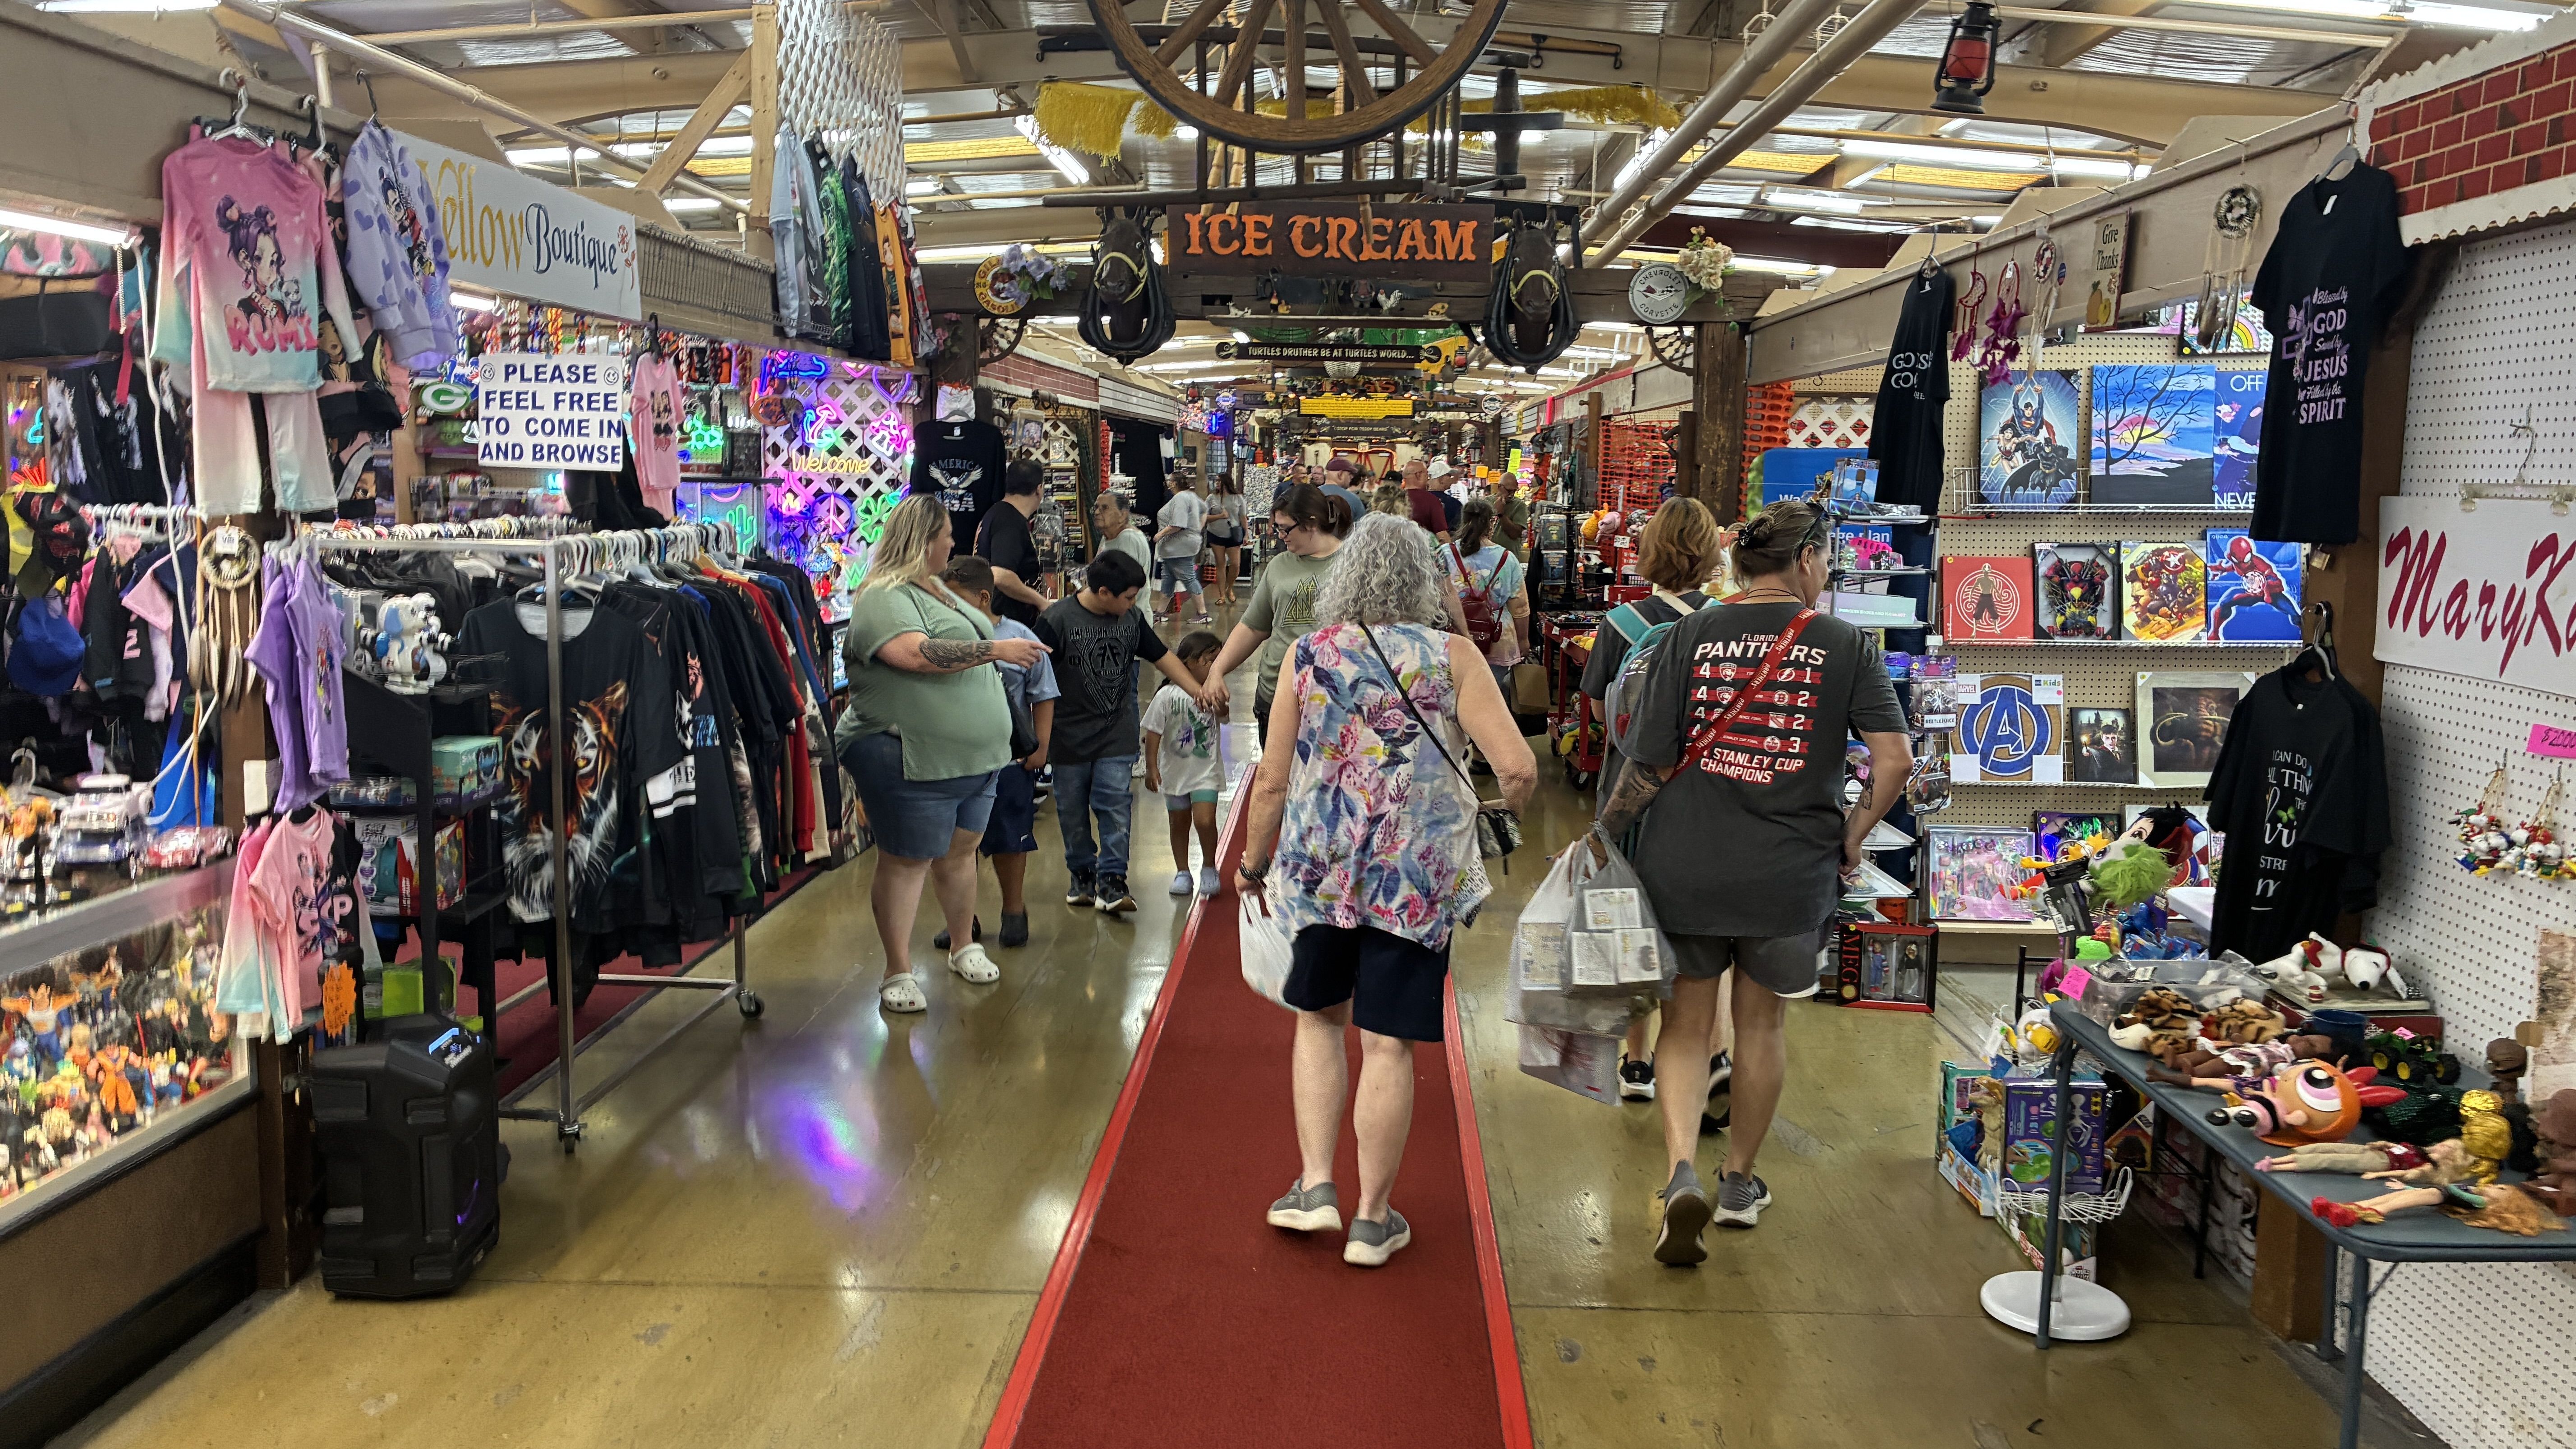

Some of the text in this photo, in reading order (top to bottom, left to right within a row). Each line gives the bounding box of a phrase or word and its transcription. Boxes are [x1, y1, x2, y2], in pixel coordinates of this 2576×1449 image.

[526, 203, 618, 290] Boutique
[1184, 212, 1478, 262] ICE CREAM
[1639, 269, 1681, 285] CHEVROLET
[1639, 303, 1679, 317] CORVETTE
[2313, 308, 2347, 334] GOD
[224, 302, 318, 357] RUMI
[1248, 346, 1281, 356] TURTLES
[1282, 347, 1319, 357] DRUTHER
[1320, 349, 1330, 357] BE
[1332, 349, 1343, 358] AT
[1345, 349, 1378, 358] TURTLES
[504, 363, 597, 384] PLEASE
[2303, 354, 2348, 382] JESUS
[2230, 374, 2264, 392] OFF
[484, 390, 618, 412] FEEL FREE
[2299, 397, 2346, 424] SPIRIT
[481, 416, 622, 439] TO COME IN
[480, 442, 620, 465] AND BROWSE
[791, 448, 870, 474] Welcome
[931, 458, 980, 471] AMERICA
[1742, 633, 1779, 642] FLORIDA
[1775, 627, 1794, 654] PANTHERS
[1693, 641, 1826, 666] PANTHRS
[1699, 662, 1812, 684] 4 1
[1750, 662, 1770, 690] PANTHERS
[1696, 685, 1707, 701] 4
[1797, 690, 1810, 707] 2
[1694, 706, 1706, 719] 4
[1792, 714, 1806, 730] 2
[1724, 697, 1744, 722] PANTHERS
[1695, 728, 1716, 750] PANTHERS
[1788, 736, 1801, 753] 3
[1713, 747, 1804, 771] STANLEY CUP
[2275, 750, 2292, 764] CAN
[2295, 754, 2307, 769] DO
[1700, 758, 1774, 784] CHAMPIONS
